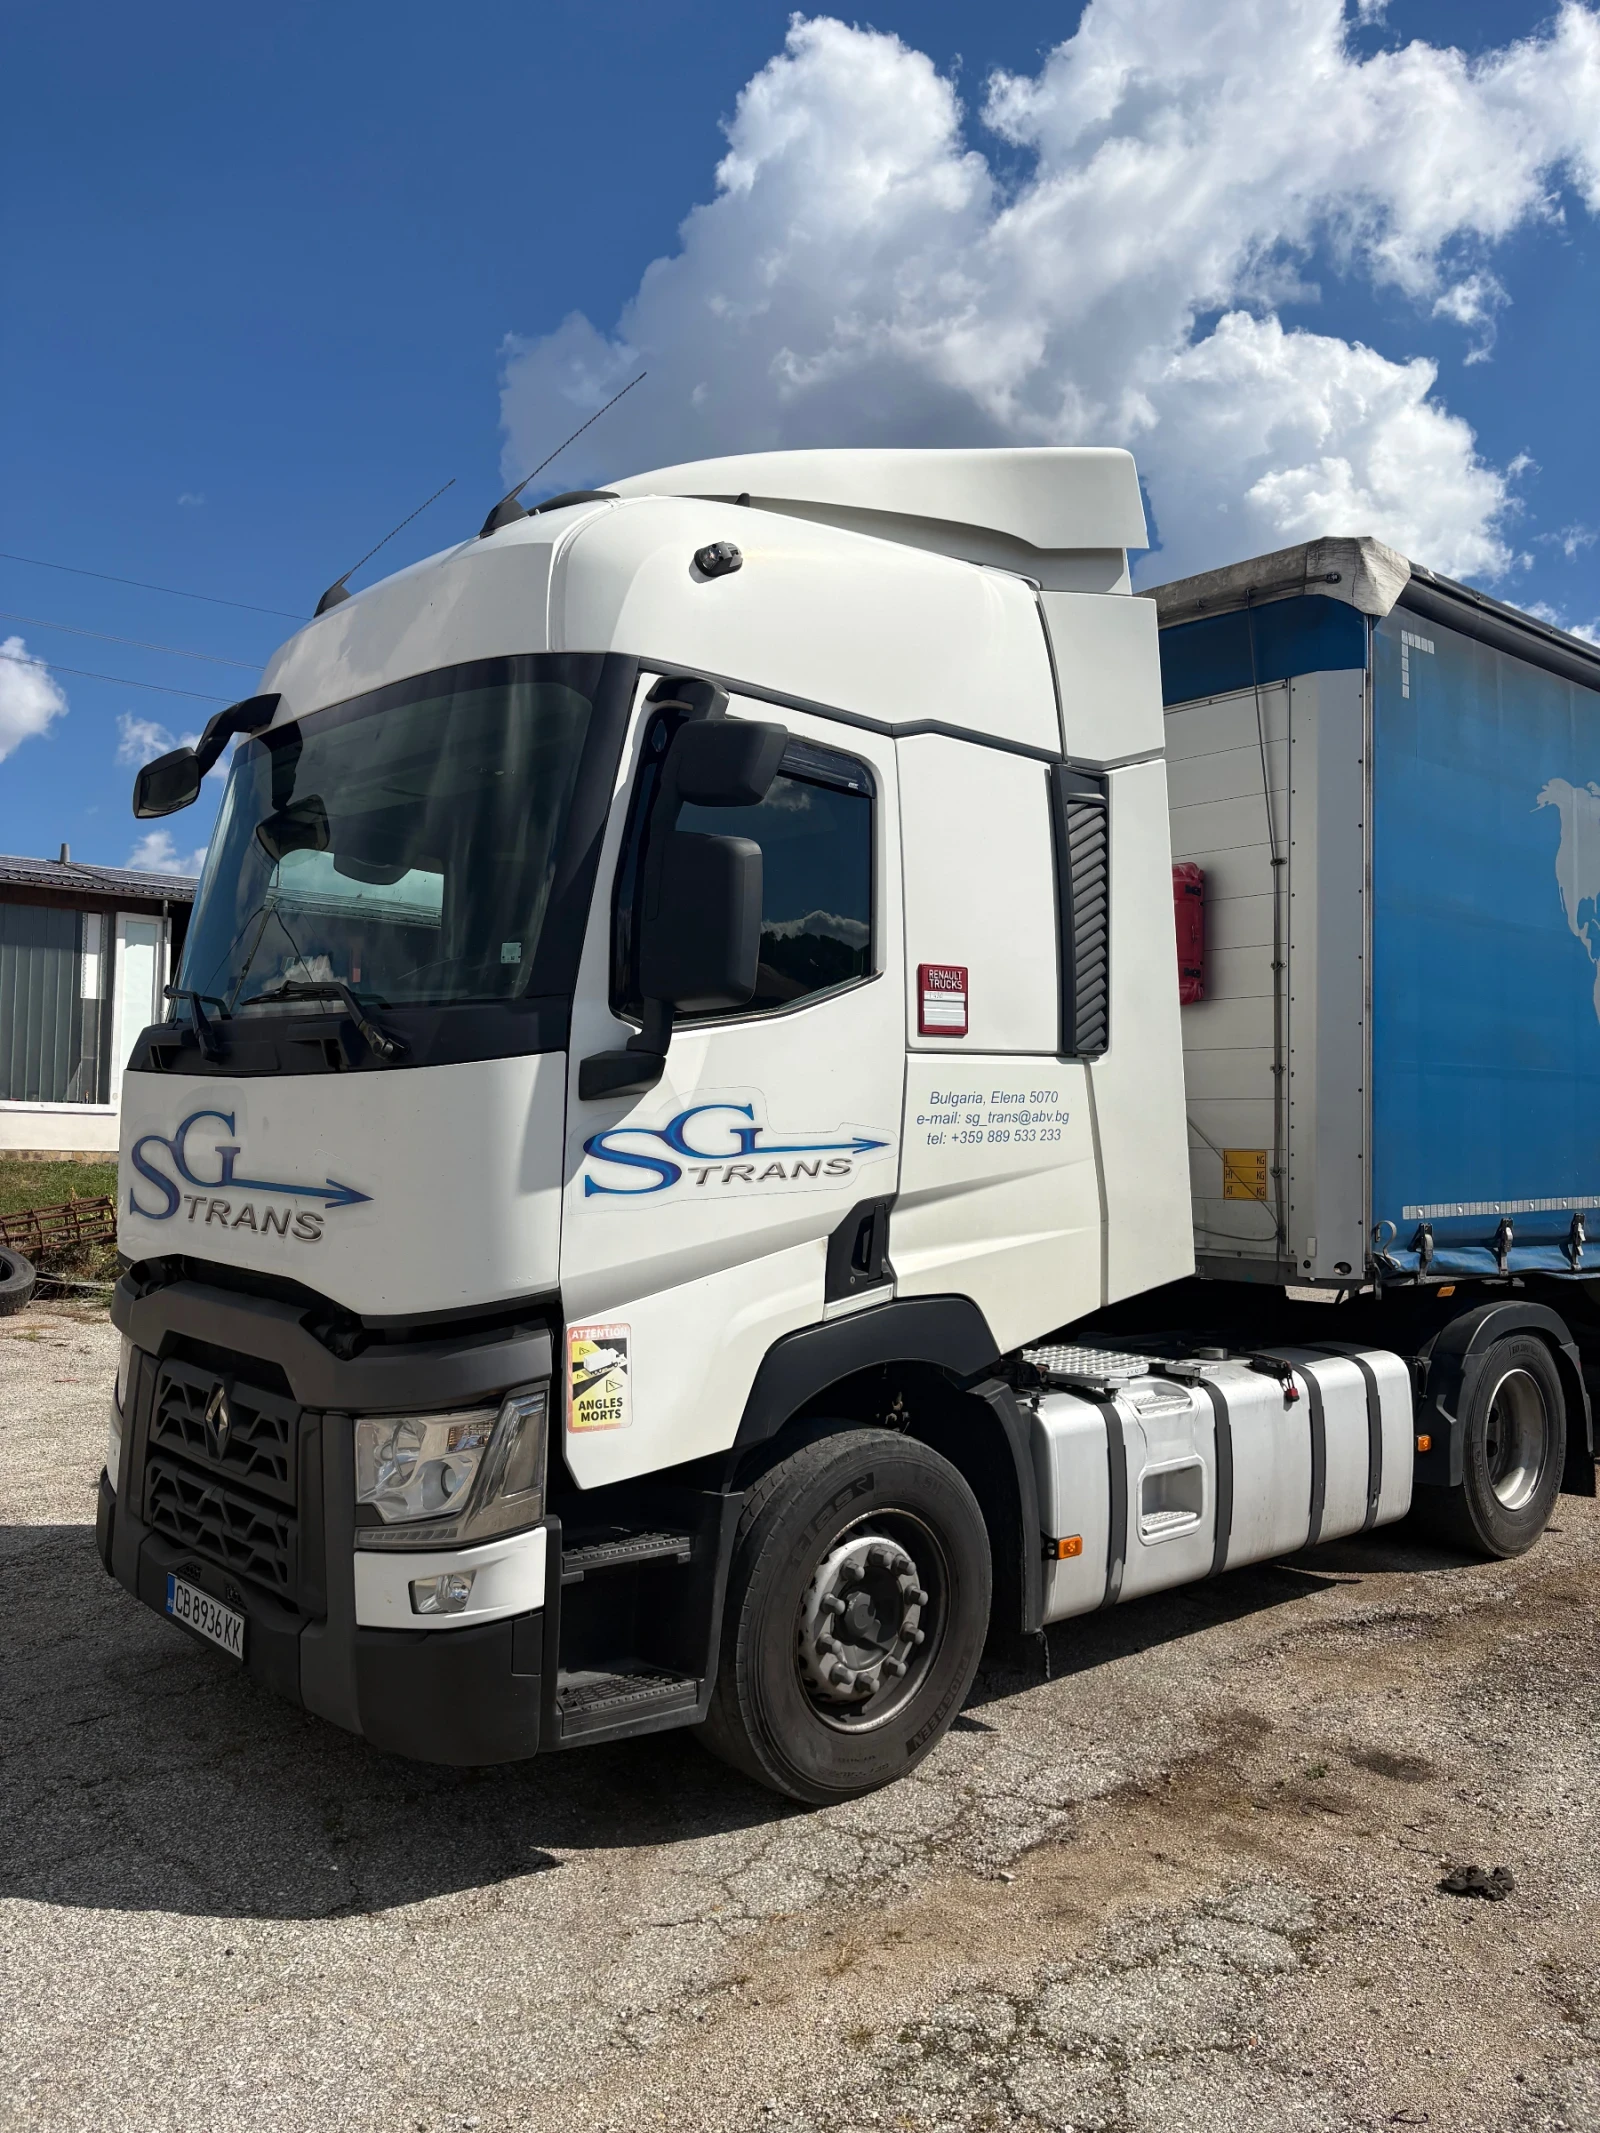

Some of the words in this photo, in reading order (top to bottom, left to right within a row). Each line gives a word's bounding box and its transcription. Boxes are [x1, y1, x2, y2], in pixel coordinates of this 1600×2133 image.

[929, 969, 963, 981] RENAULT
[929, 979, 963, 990] TRUCKS
[930, 1091, 986, 1107] Bulgaria,
[991, 1091, 1025, 1104] Elena
[1029, 1090, 1058, 1103] 5070
[916, 1111, 961, 1125] e-mail:
[965, 1110, 1069, 1127] sg_trans@abv.bg
[926, 1132, 947, 1145] tel:
[951, 1131, 983, 1144] +359
[987, 1130, 1010, 1143] 889
[1014, 1129, 1036, 1142] 533
[1040, 1129, 1061, 1141] 233
[1256, 1155, 1265, 1165] KG
[687, 1157, 853, 1187] TRANS
[1256, 1170, 1265, 1181] KG
[1256, 1186, 1265, 1197] KG
[184, 1193, 325, 1242] TRANS
[572, 1327, 627, 1340] ATTENTION
[578, 1396, 623, 1411] ANGLES
[581, 1408, 621, 1423] MORTS
